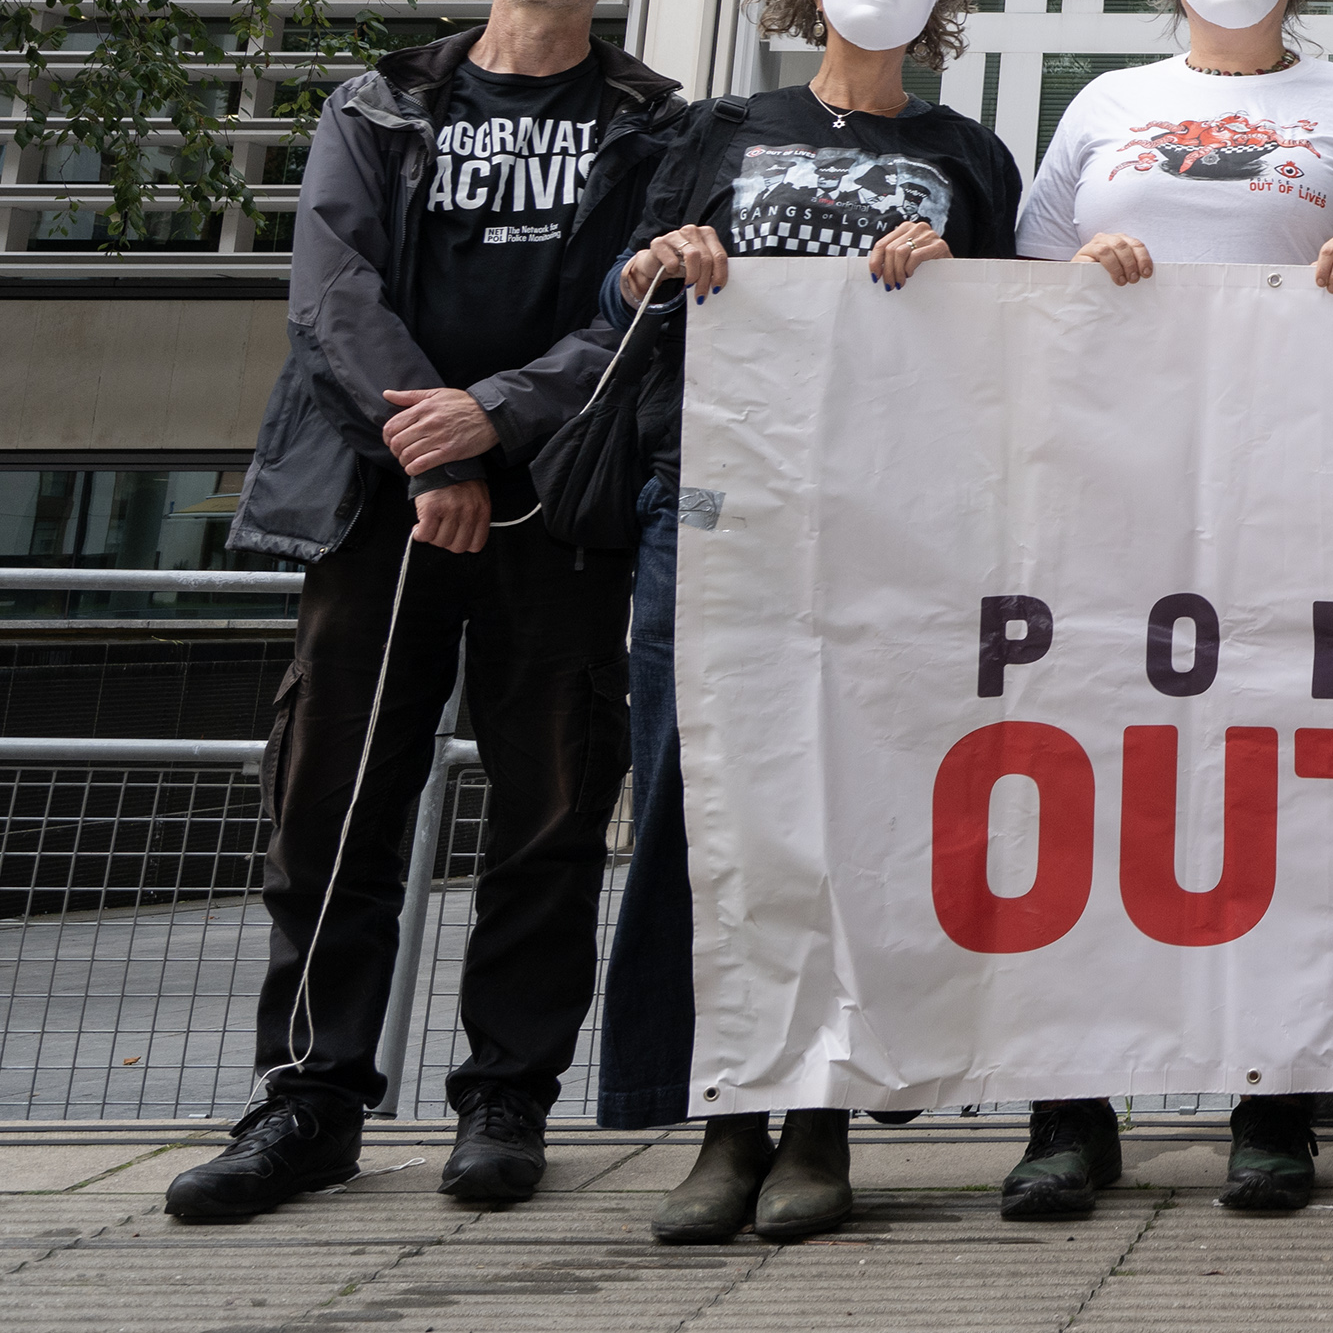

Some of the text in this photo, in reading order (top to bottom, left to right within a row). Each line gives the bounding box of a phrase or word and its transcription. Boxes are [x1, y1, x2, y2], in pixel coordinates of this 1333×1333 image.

[436, 117, 598, 159] AGGRAVAT
[1250, 182, 1326, 208] OUT OF LIVES
[740, 205, 812, 220] GANGS
[836, 200, 870, 212] original
[508, 226, 520, 234] The
[522, 225, 548, 234] Network
[528, 230, 561, 242] Monitoring
